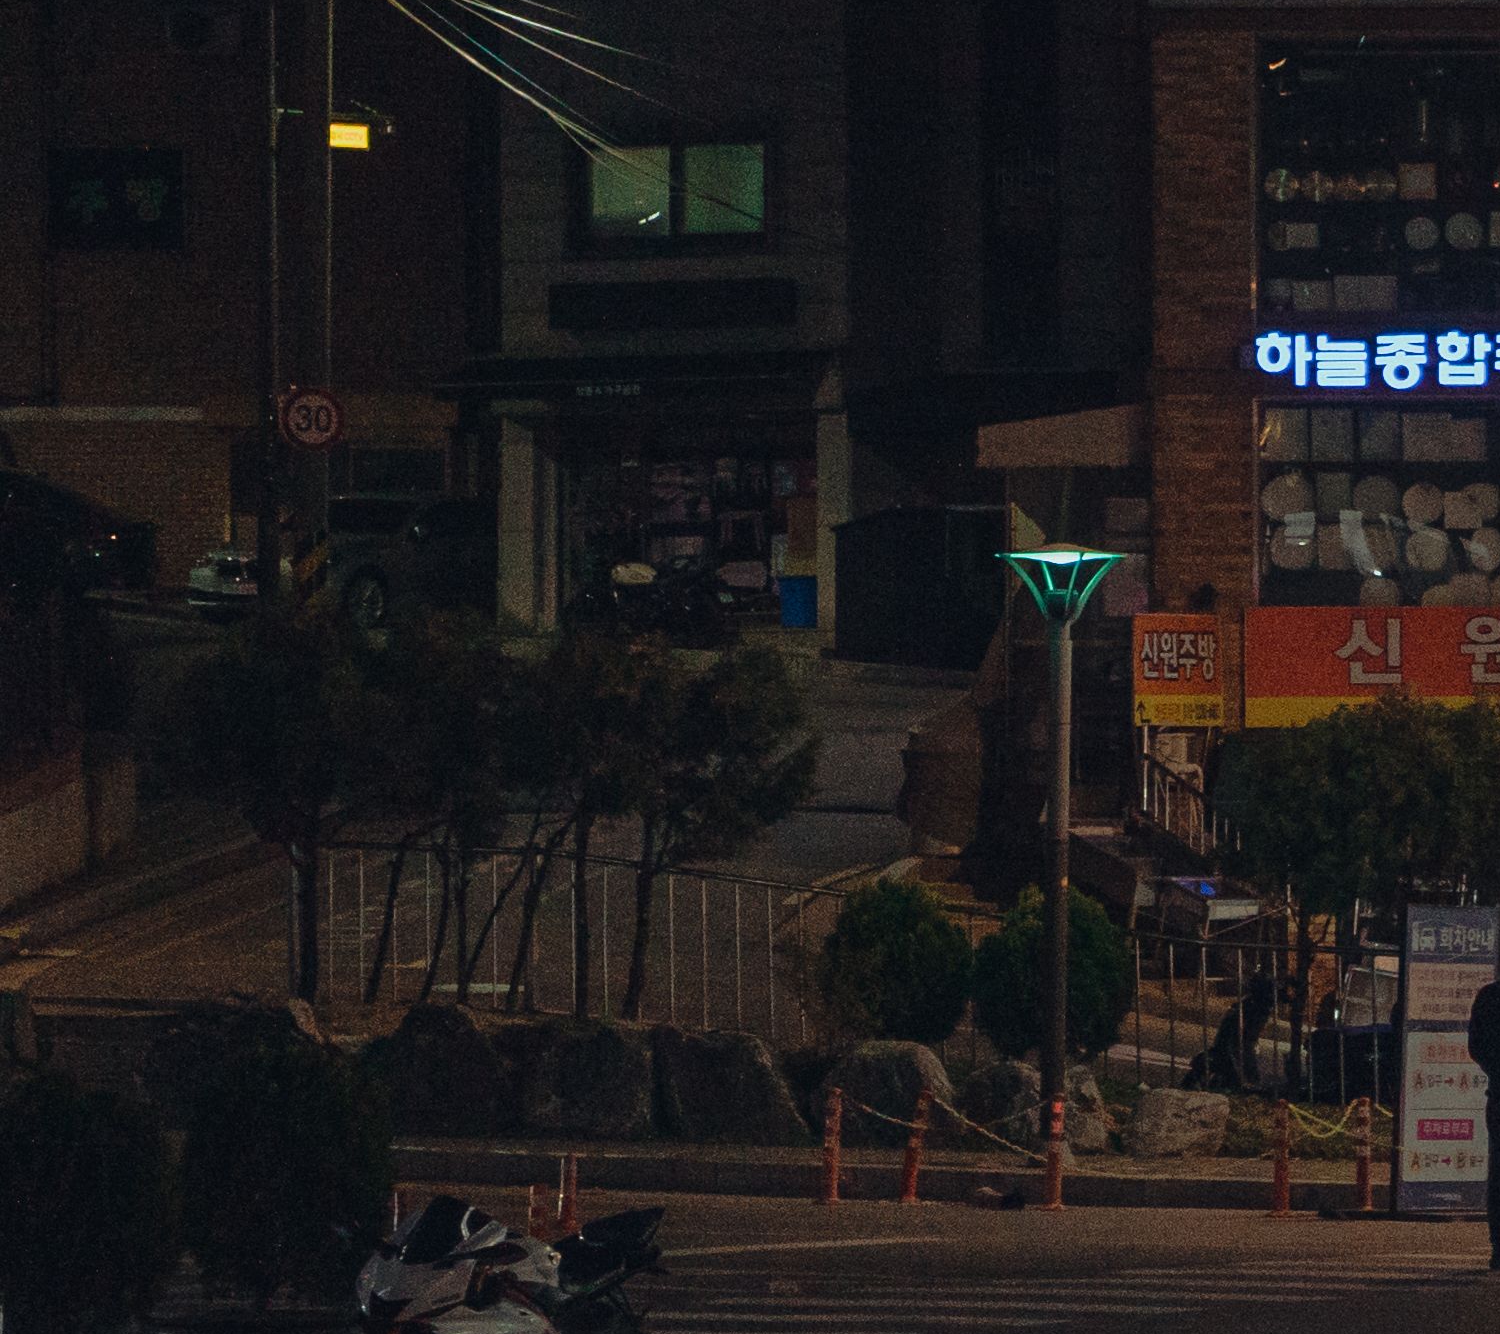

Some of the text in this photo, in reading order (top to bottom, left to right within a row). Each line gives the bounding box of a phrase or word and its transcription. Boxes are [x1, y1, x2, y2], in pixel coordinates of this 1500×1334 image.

[297, 403, 333, 433] 30
[1139, 630, 1217, 681] 신원주방
[1439, 928, 1496, 952] 회차안내
